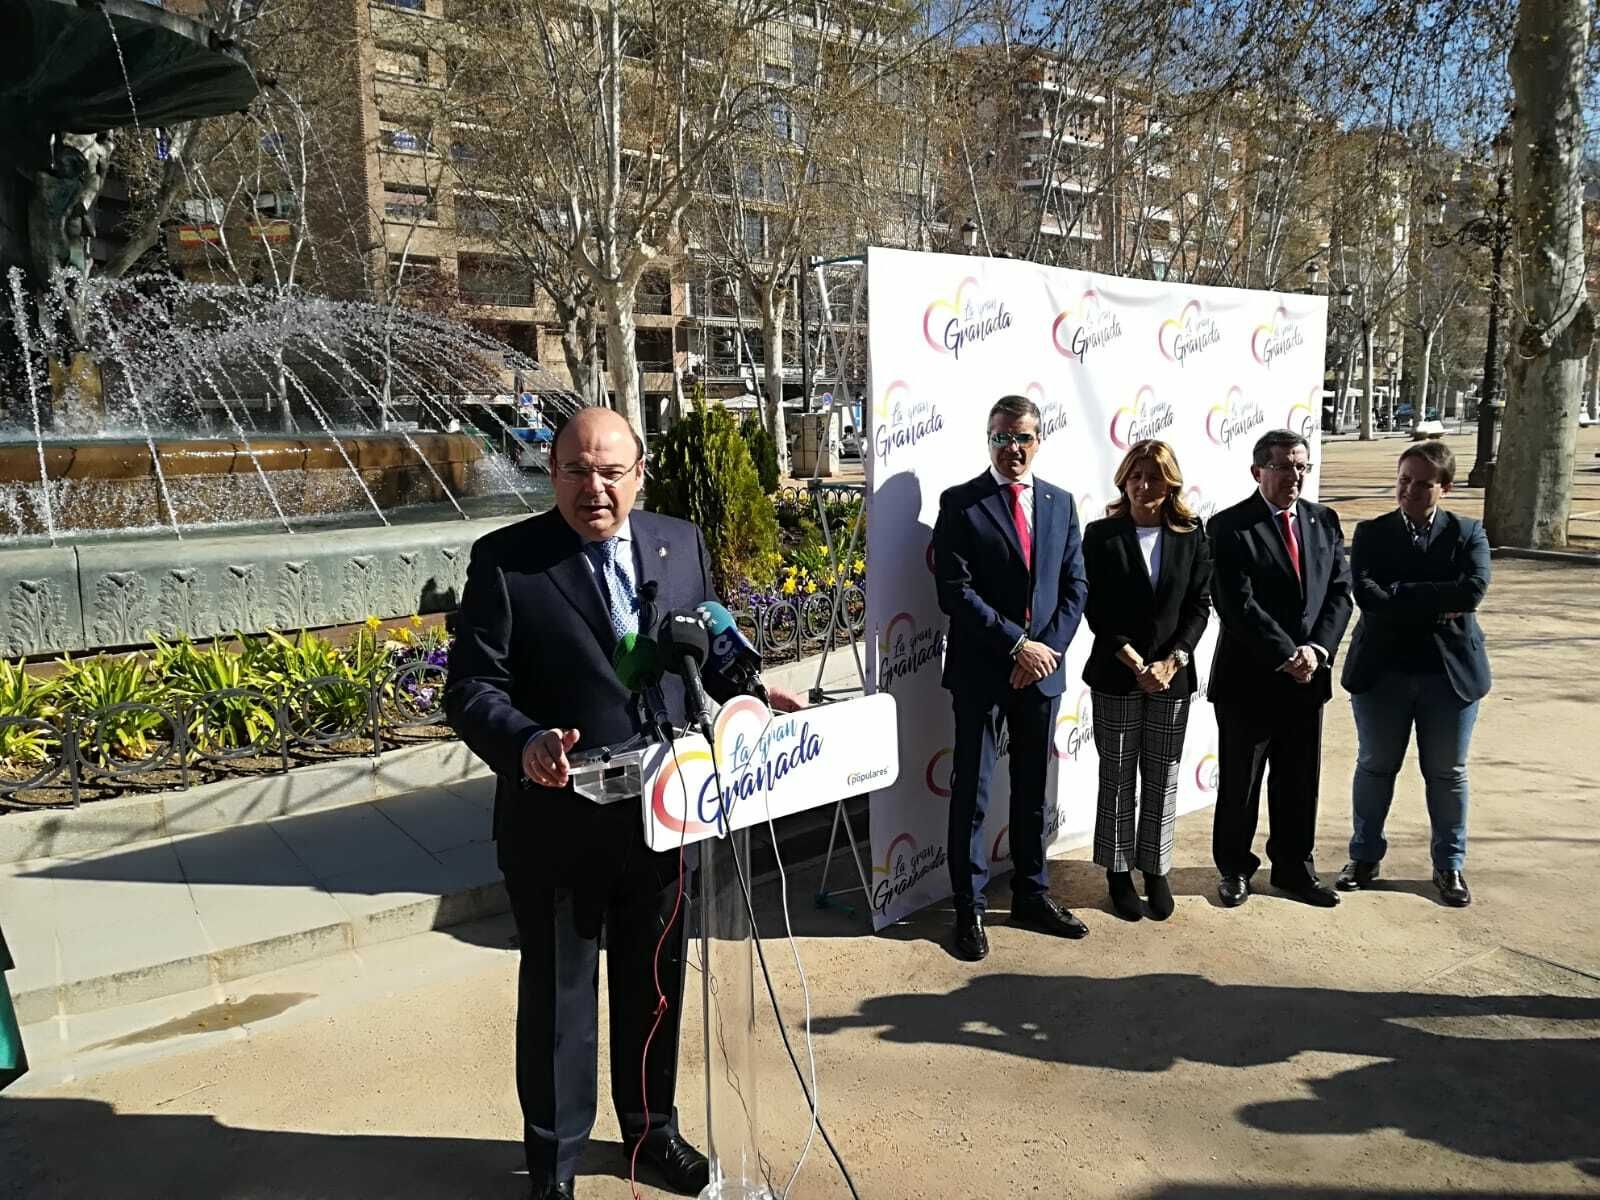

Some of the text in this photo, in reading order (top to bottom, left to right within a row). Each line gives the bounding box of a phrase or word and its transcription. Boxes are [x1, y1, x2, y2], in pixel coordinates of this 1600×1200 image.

[944, 302, 1013, 361] Granada
[1072, 314, 1122, 365] Granada
[1174, 319, 1221, 369] Granada
[1263, 325, 1304, 369] Granada
[875, 404, 944, 466] Granada
[1127, 404, 1174, 446] Granada
[1220, 403, 1264, 450] Granada
[730, 719, 797, 773] La gran
[698, 721, 824, 836] Granada
[850, 768, 888, 786] populares
[873, 847, 946, 917] Granada
